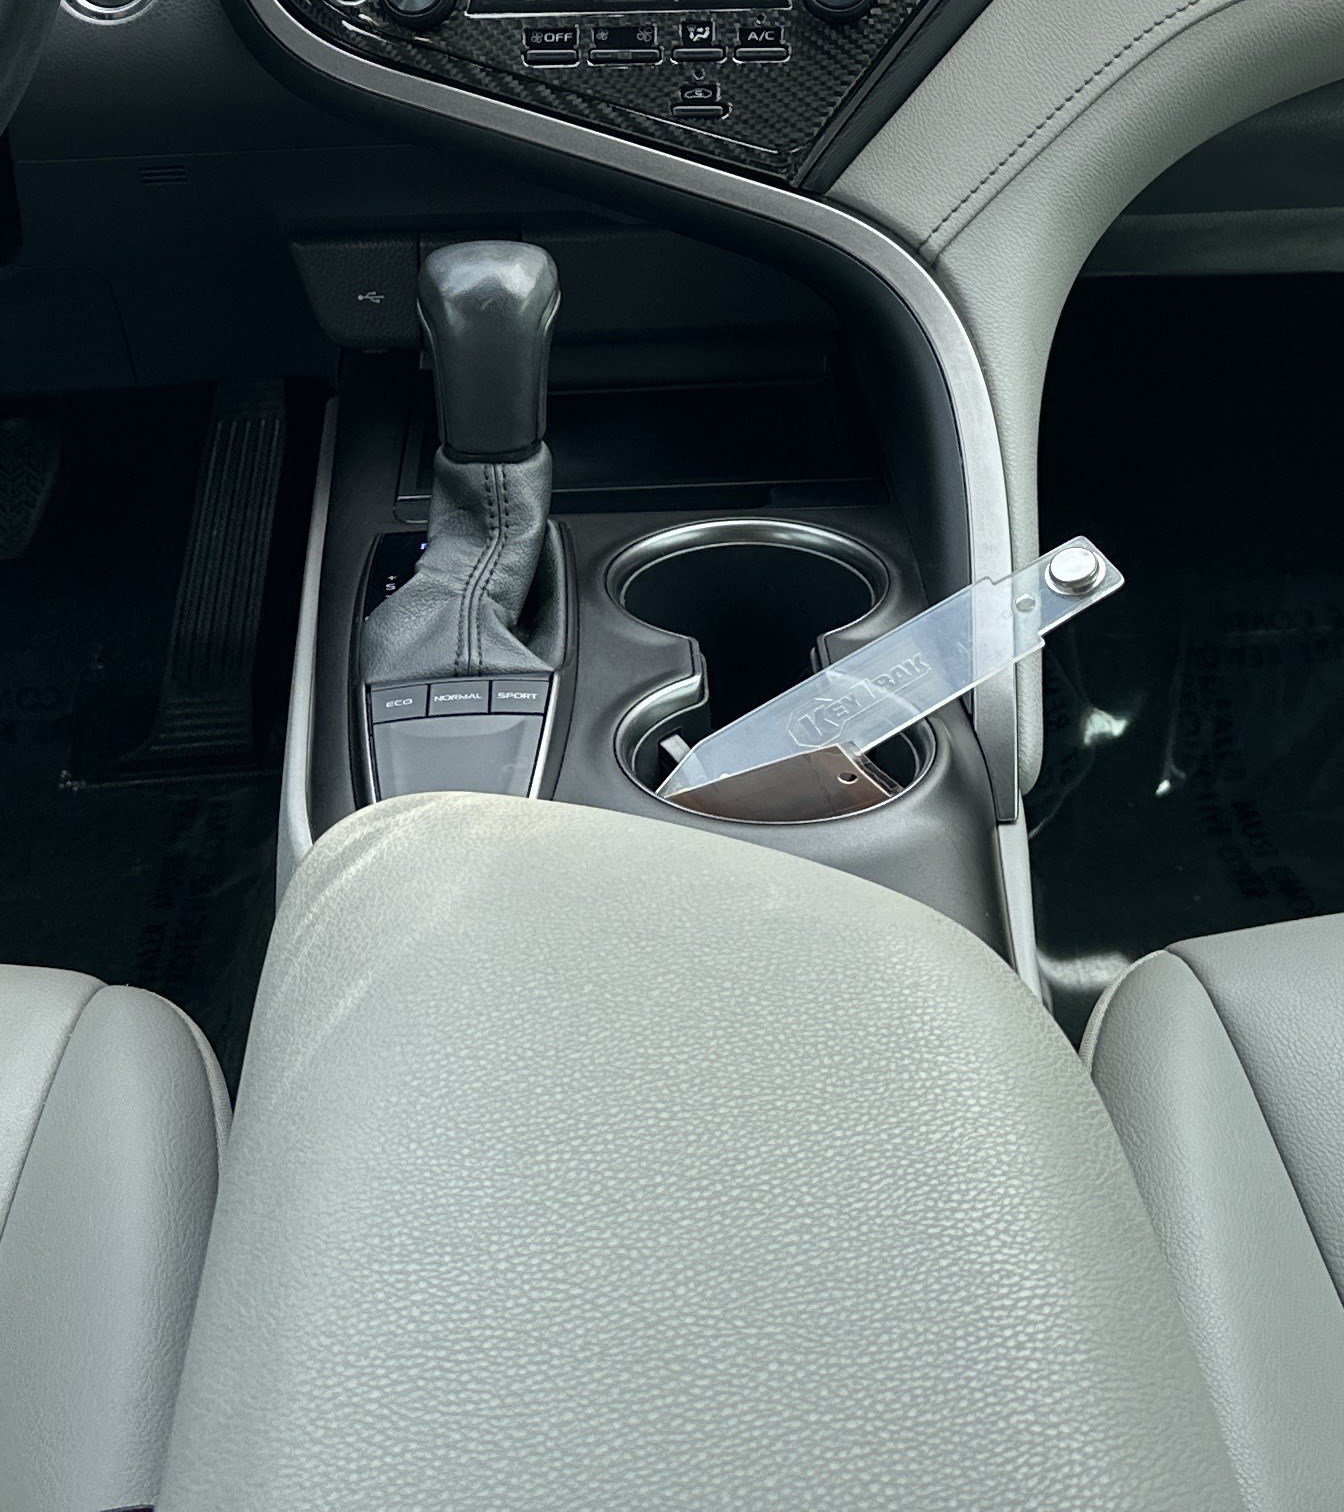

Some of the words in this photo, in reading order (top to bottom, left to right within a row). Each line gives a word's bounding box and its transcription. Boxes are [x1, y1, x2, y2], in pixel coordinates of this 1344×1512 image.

[543, 32, 574, 42] OFF
[747, 30, 775, 41] A/C
[433, 692, 483, 702] NORMAL
[497, 691, 538, 701] SPORT
[385, 698, 413, 708] ECO
